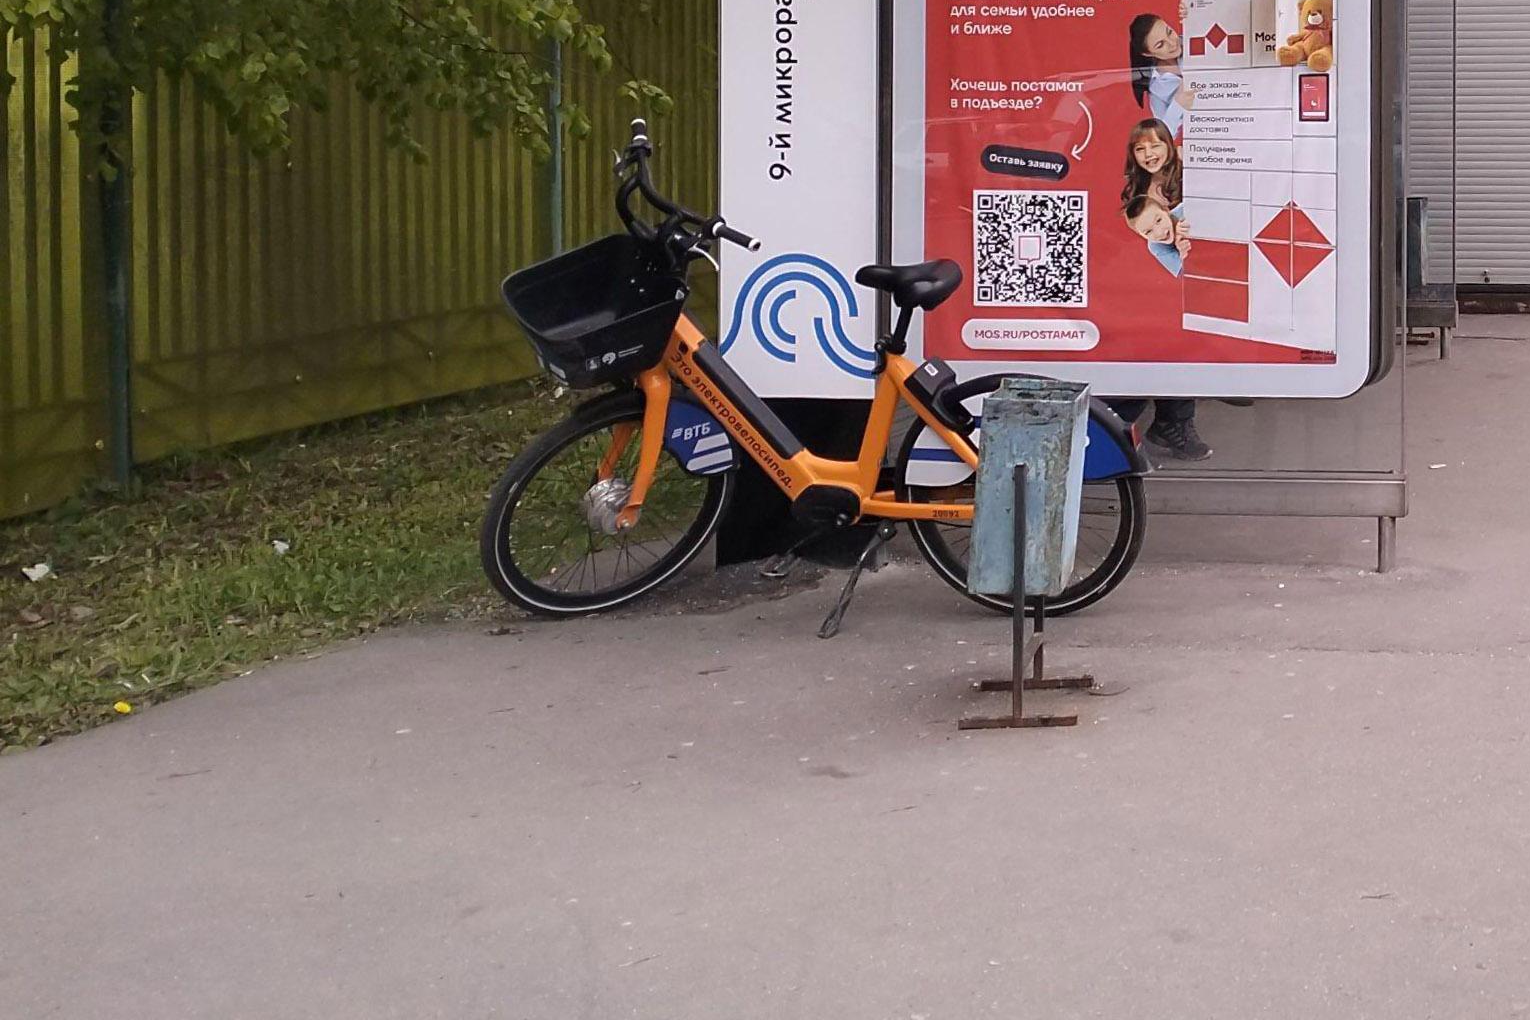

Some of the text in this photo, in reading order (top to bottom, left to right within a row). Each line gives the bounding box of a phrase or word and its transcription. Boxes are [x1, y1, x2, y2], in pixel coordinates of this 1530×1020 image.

[950, 4, 1095, 19] для семьи удобнее
[950, 22, 1012, 35] и ближе
[950, 78, 1084, 92] Хочешь постамат
[950, 95, 1043, 111] в подъезде?
[1190, 114, 1254, 123] Бесконтактная
[769, 133, 793, 181] 9-й
[989, 153, 1064, 173] Оставь заявку
[974, 330, 1086, 340] MOS.RU/POSTAMAT
[671, 353, 793, 489] Это электровелосипед.
